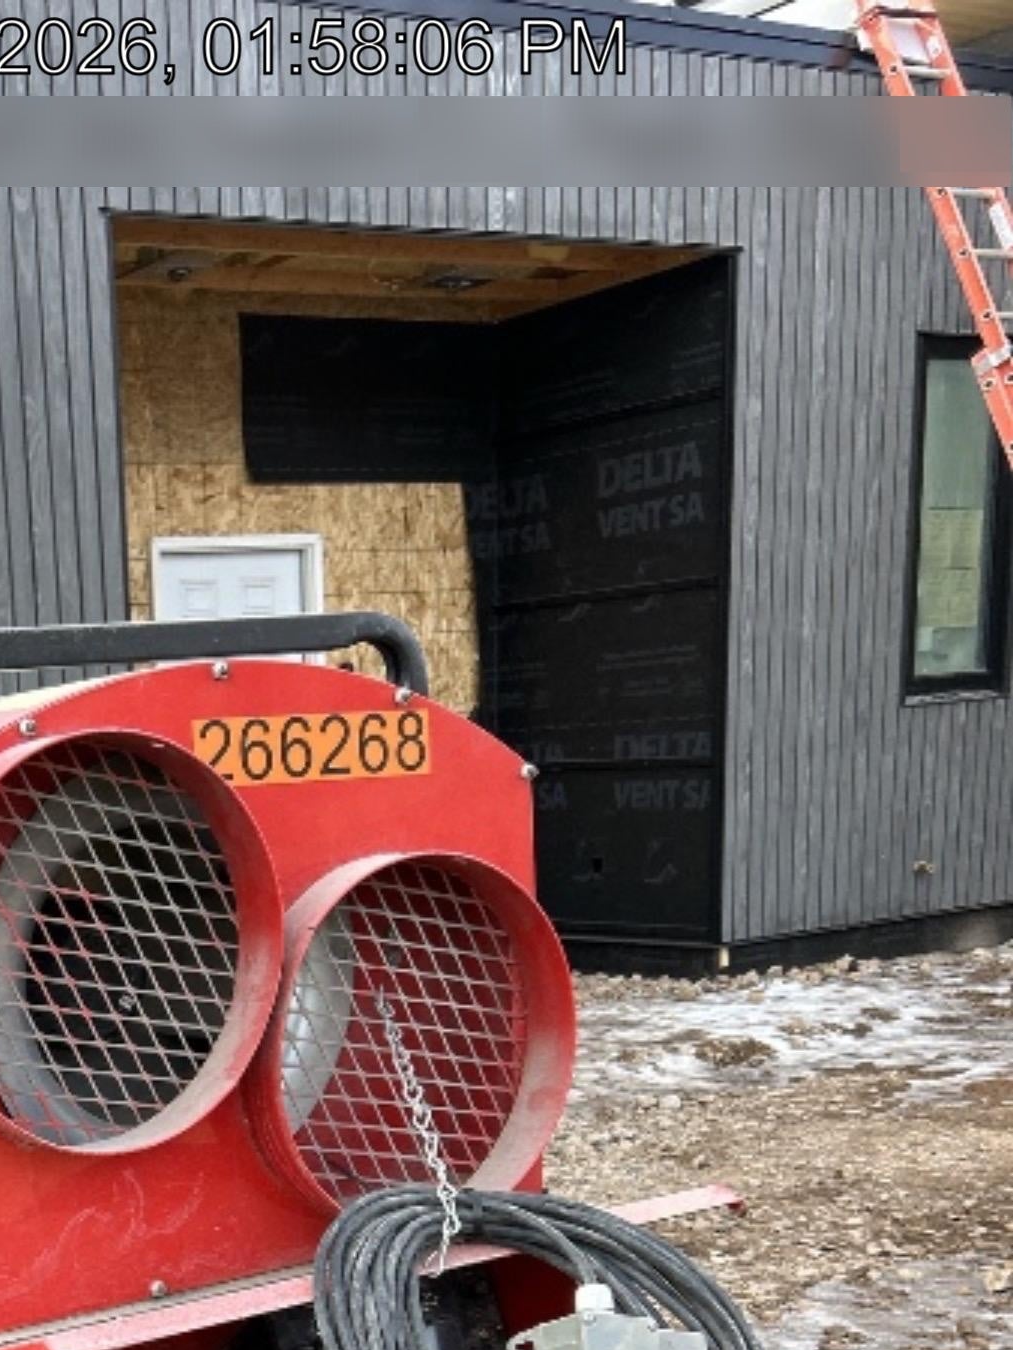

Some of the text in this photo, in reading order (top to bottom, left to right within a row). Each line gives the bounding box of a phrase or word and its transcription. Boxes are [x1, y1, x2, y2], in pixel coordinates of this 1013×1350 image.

[597, 440, 702, 498] DELTA
[597, 491, 706, 538] VENT SA
[199, 710, 427, 781] 266268
